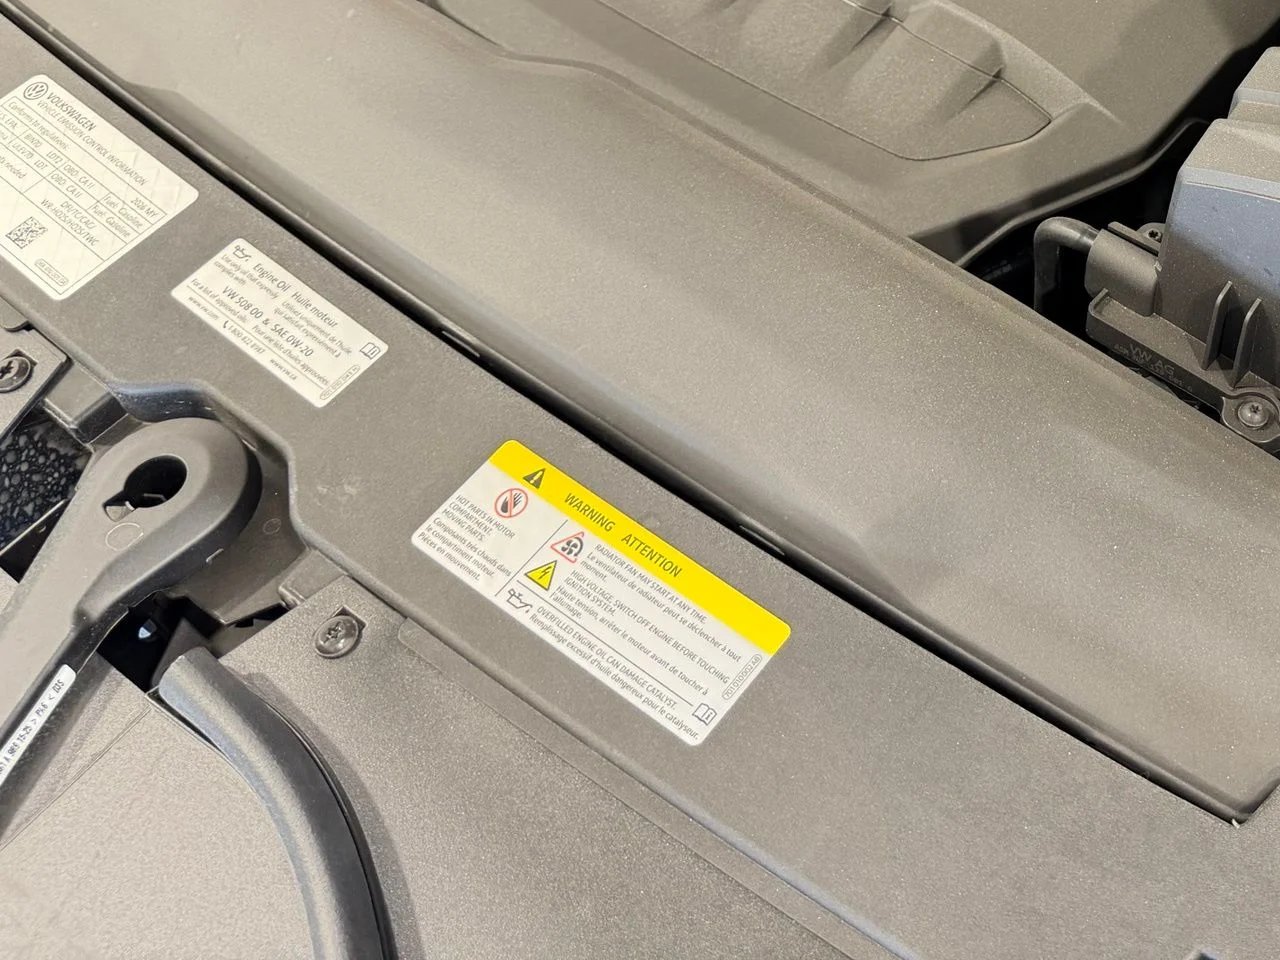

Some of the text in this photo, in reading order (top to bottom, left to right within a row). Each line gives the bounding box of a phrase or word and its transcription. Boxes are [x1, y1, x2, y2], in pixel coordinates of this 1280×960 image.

[7, 101, 34, 122] Conforms
[31, 119, 40, 127] to
[46, 92, 96, 131] VOLKSWAGEN
[36, 99, 147, 186] VEHICLE EMISSION CONTROL INFORMATION
[104, 216, 131, 238] Gasoline
[117, 206, 144, 228] Gasoline
[130, 197, 158, 218] 2026 MY
[251, 262, 291, 292] Engine Oil
[221, 285, 314, 357] VW 508 00 & SAE 0W-20
[290, 291, 339, 328] Huile moteur
[441, 508, 485, 541] MOVING PARTS.
[448, 501, 493, 535] COMPARTMENT.
[455, 494, 515, 539] HOT PARTS IN MOTOR
[563, 492, 682, 577] WARNING ATTENTION
[425, 524, 495, 578] le compartiment moteur.
[432, 517, 468, 545] Composants
[476, 548, 498, 566] chauds
[495, 563, 512, 576] dans
[435, 545, 445, 554] en
[443, 551, 481, 580] mouvement.
[579, 560, 607, 582] moment.
[594, 543, 707, 624] RADIATOR FAN MAY START AT ANY TIME.
[548, 591, 583, 619] l'allumage.
[563, 576, 616, 616] IGNITION SYSTEM.
[586, 551, 596, 561] Le
[594, 558, 628, 583] ventilateur
[626, 580, 637, 589] de
[635, 586, 665, 608] radiateur
[661, 605, 680, 620] peut
[678, 616, 688, 625] se
[686, 621, 722, 648] déclencher
[725, 648, 741, 662] tout
[555, 584, 576, 601] Haute
[573, 598, 600, 620] tension,
[620, 629, 629, 639] le
[626, 636, 651, 655] moteur
[649, 652, 669, 668] avant
[667, 664, 679, 675] de
[677, 671, 703, 692] toucher
[570, 569, 588, 584] HIGH
[612, 599, 638, 619] SWITCH
[635, 615, 651, 628] OFF
[648, 624, 673, 644] ENGINE
[671, 640, 698, 661] BEFORE
[695, 657, 730, 684] TOUCHING
[528, 613, 699, 740] Remplissage excessif d'huile dangereux pour le catalyseur.
[536, 606, 677, 710] OVERFILLED ENGINE OIL CAN DAMAGE CATALYST.
